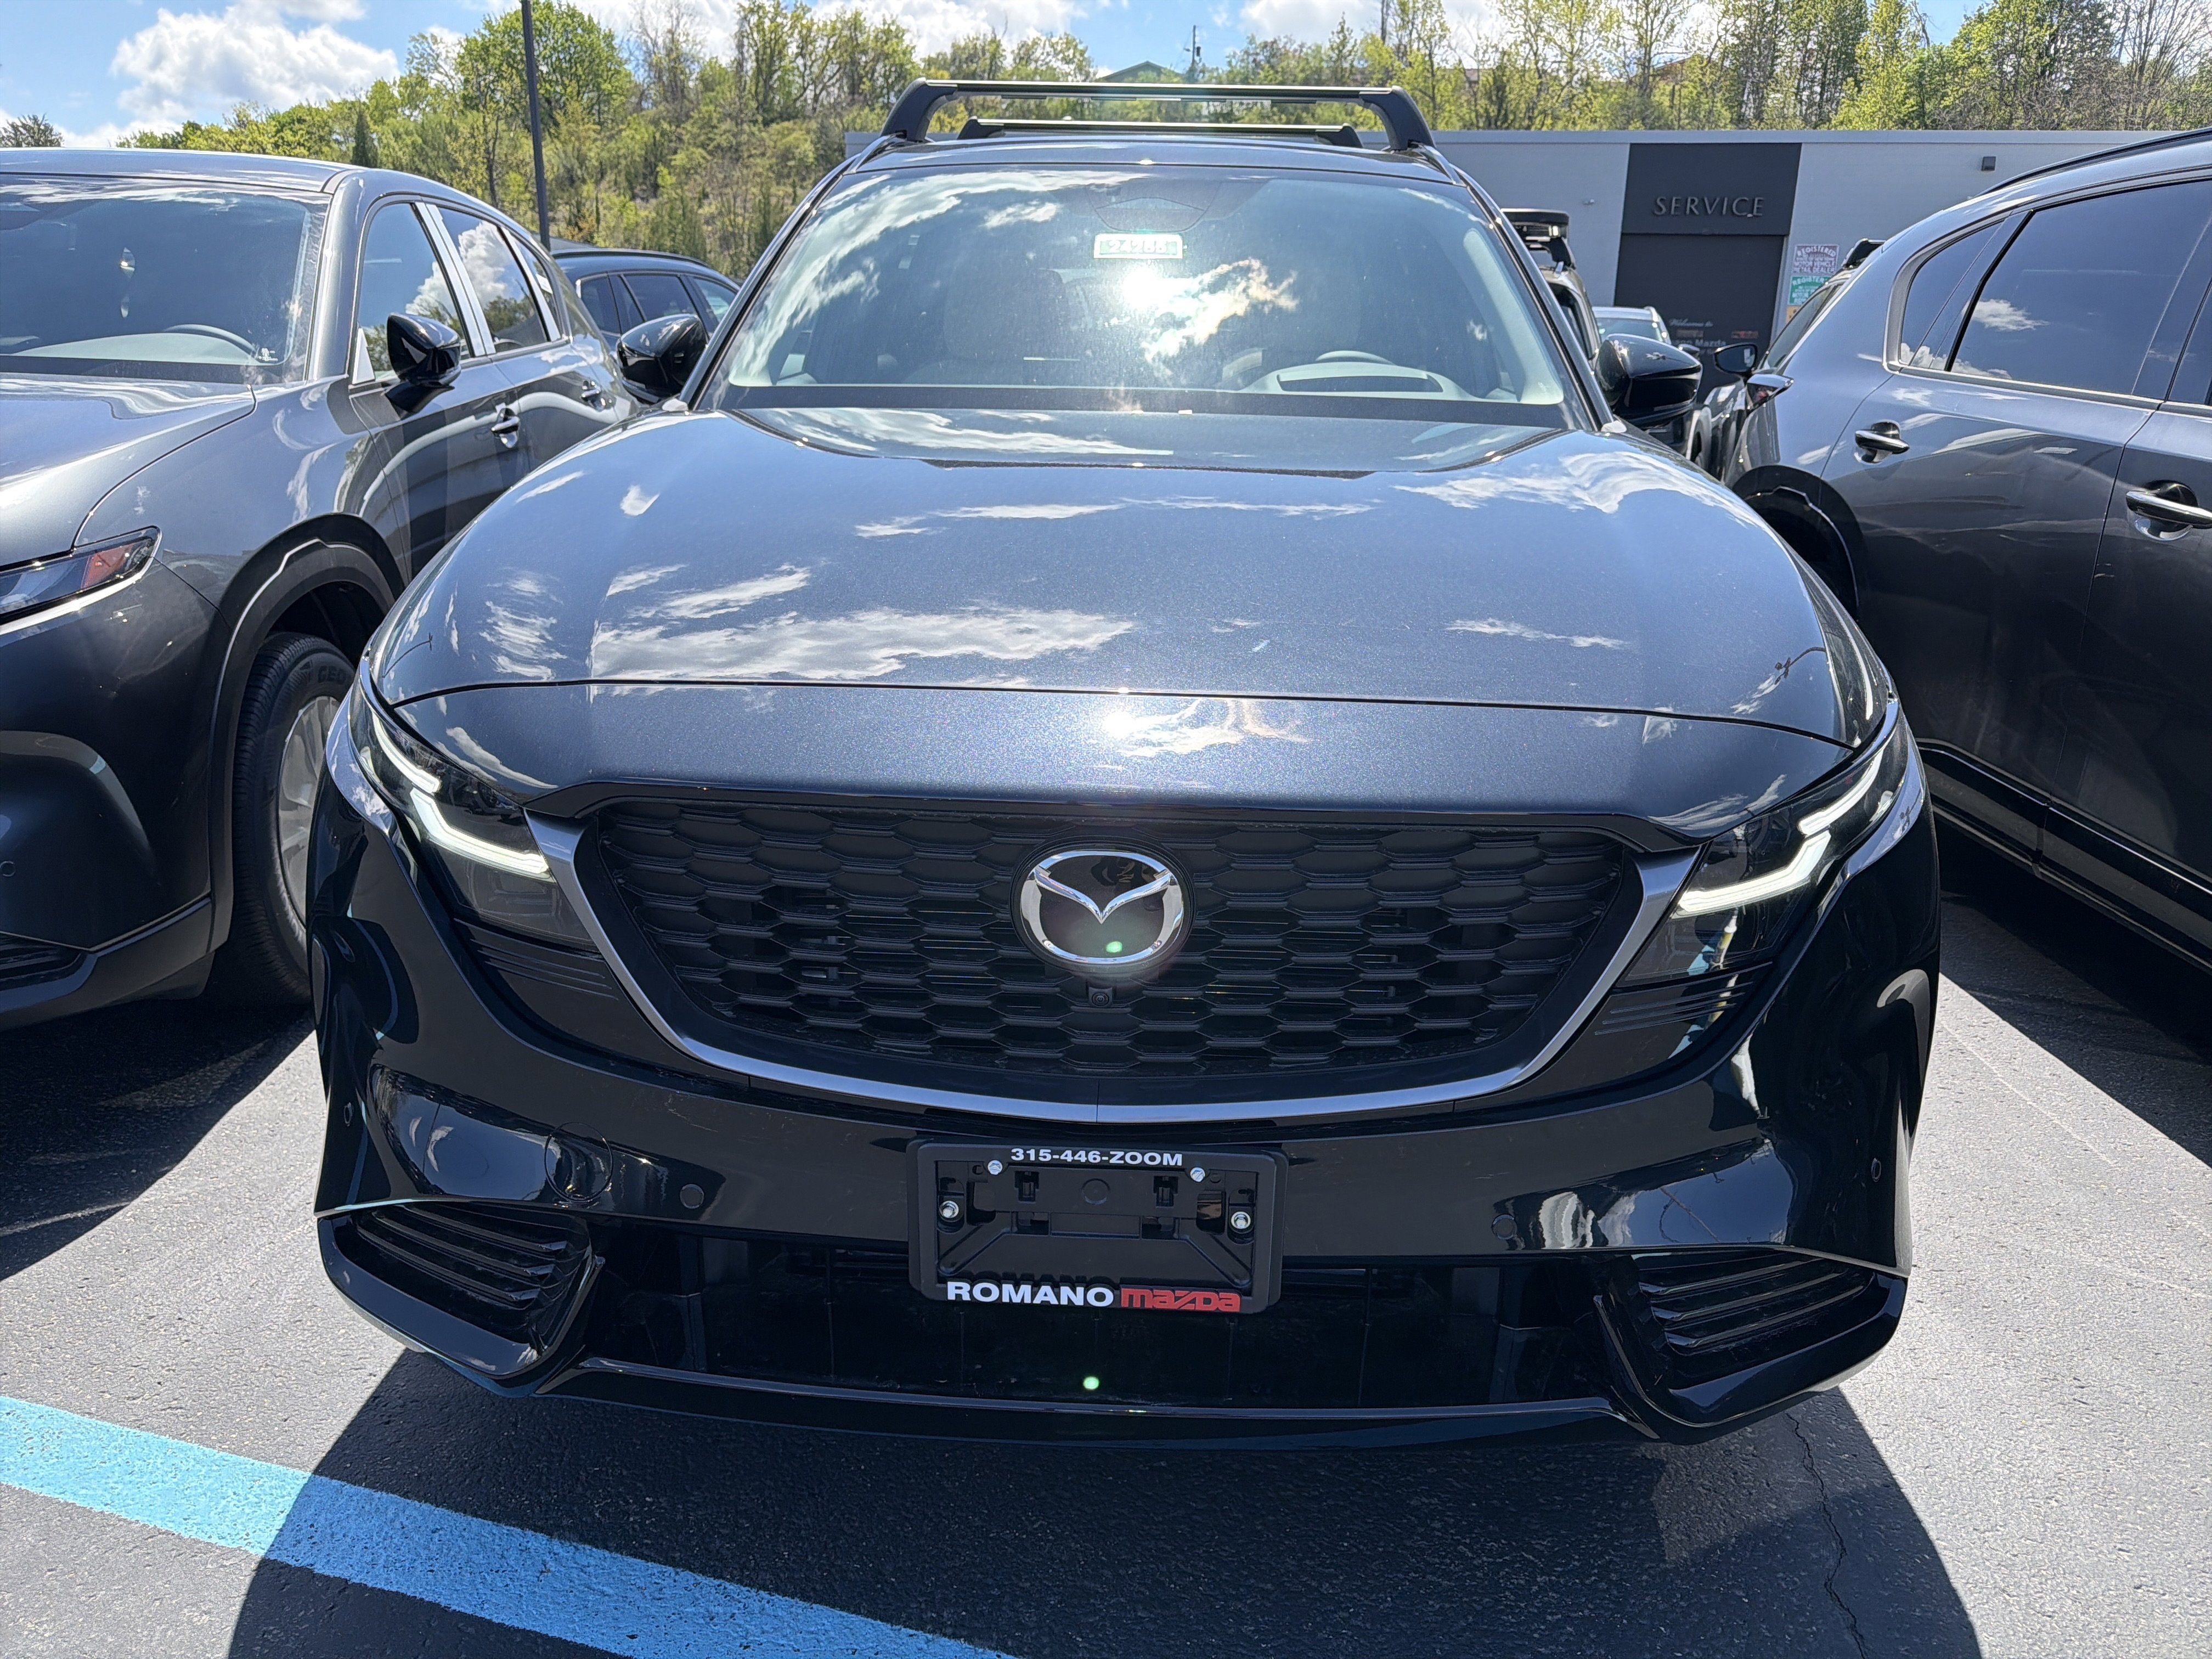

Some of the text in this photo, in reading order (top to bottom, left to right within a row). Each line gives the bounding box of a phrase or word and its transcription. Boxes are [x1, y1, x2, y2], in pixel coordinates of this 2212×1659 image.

[1654, 196, 1765, 216] SERVICE
[1797, 246, 1836, 257] REGISTERED
[1792, 276, 1829, 285] REGISTER
[318, 665, 347, 685] GEO
[1011, 1148, 1183, 1166] 315-446-ZOOM
[946, 1281, 1114, 1307] ROMANO
